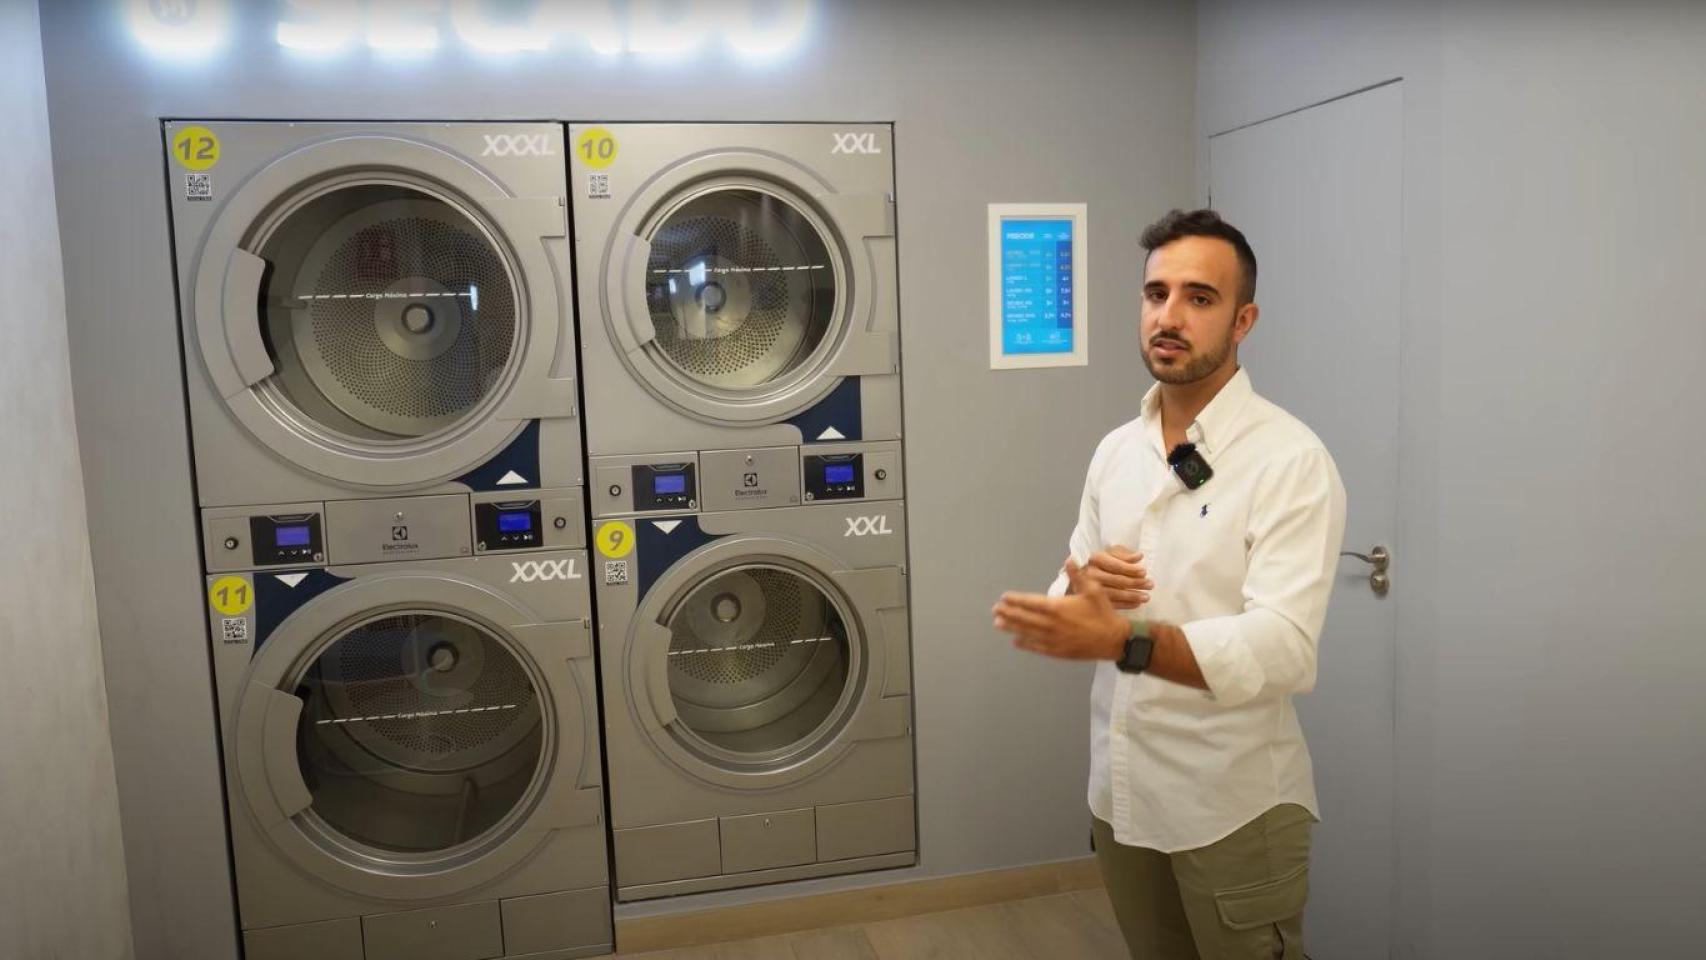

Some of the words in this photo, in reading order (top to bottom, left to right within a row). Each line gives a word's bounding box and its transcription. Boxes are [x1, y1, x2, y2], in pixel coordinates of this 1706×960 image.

[178, 136, 215, 161] 12
[481, 133, 555, 156] XXXL
[581, 137, 615, 160] 10
[831, 132, 881, 154] XXL
[844, 515, 893, 537] XXL
[609, 529, 625, 552] 9
[509, 558, 582, 584] XXXL
[216, 583, 248, 607] 11
